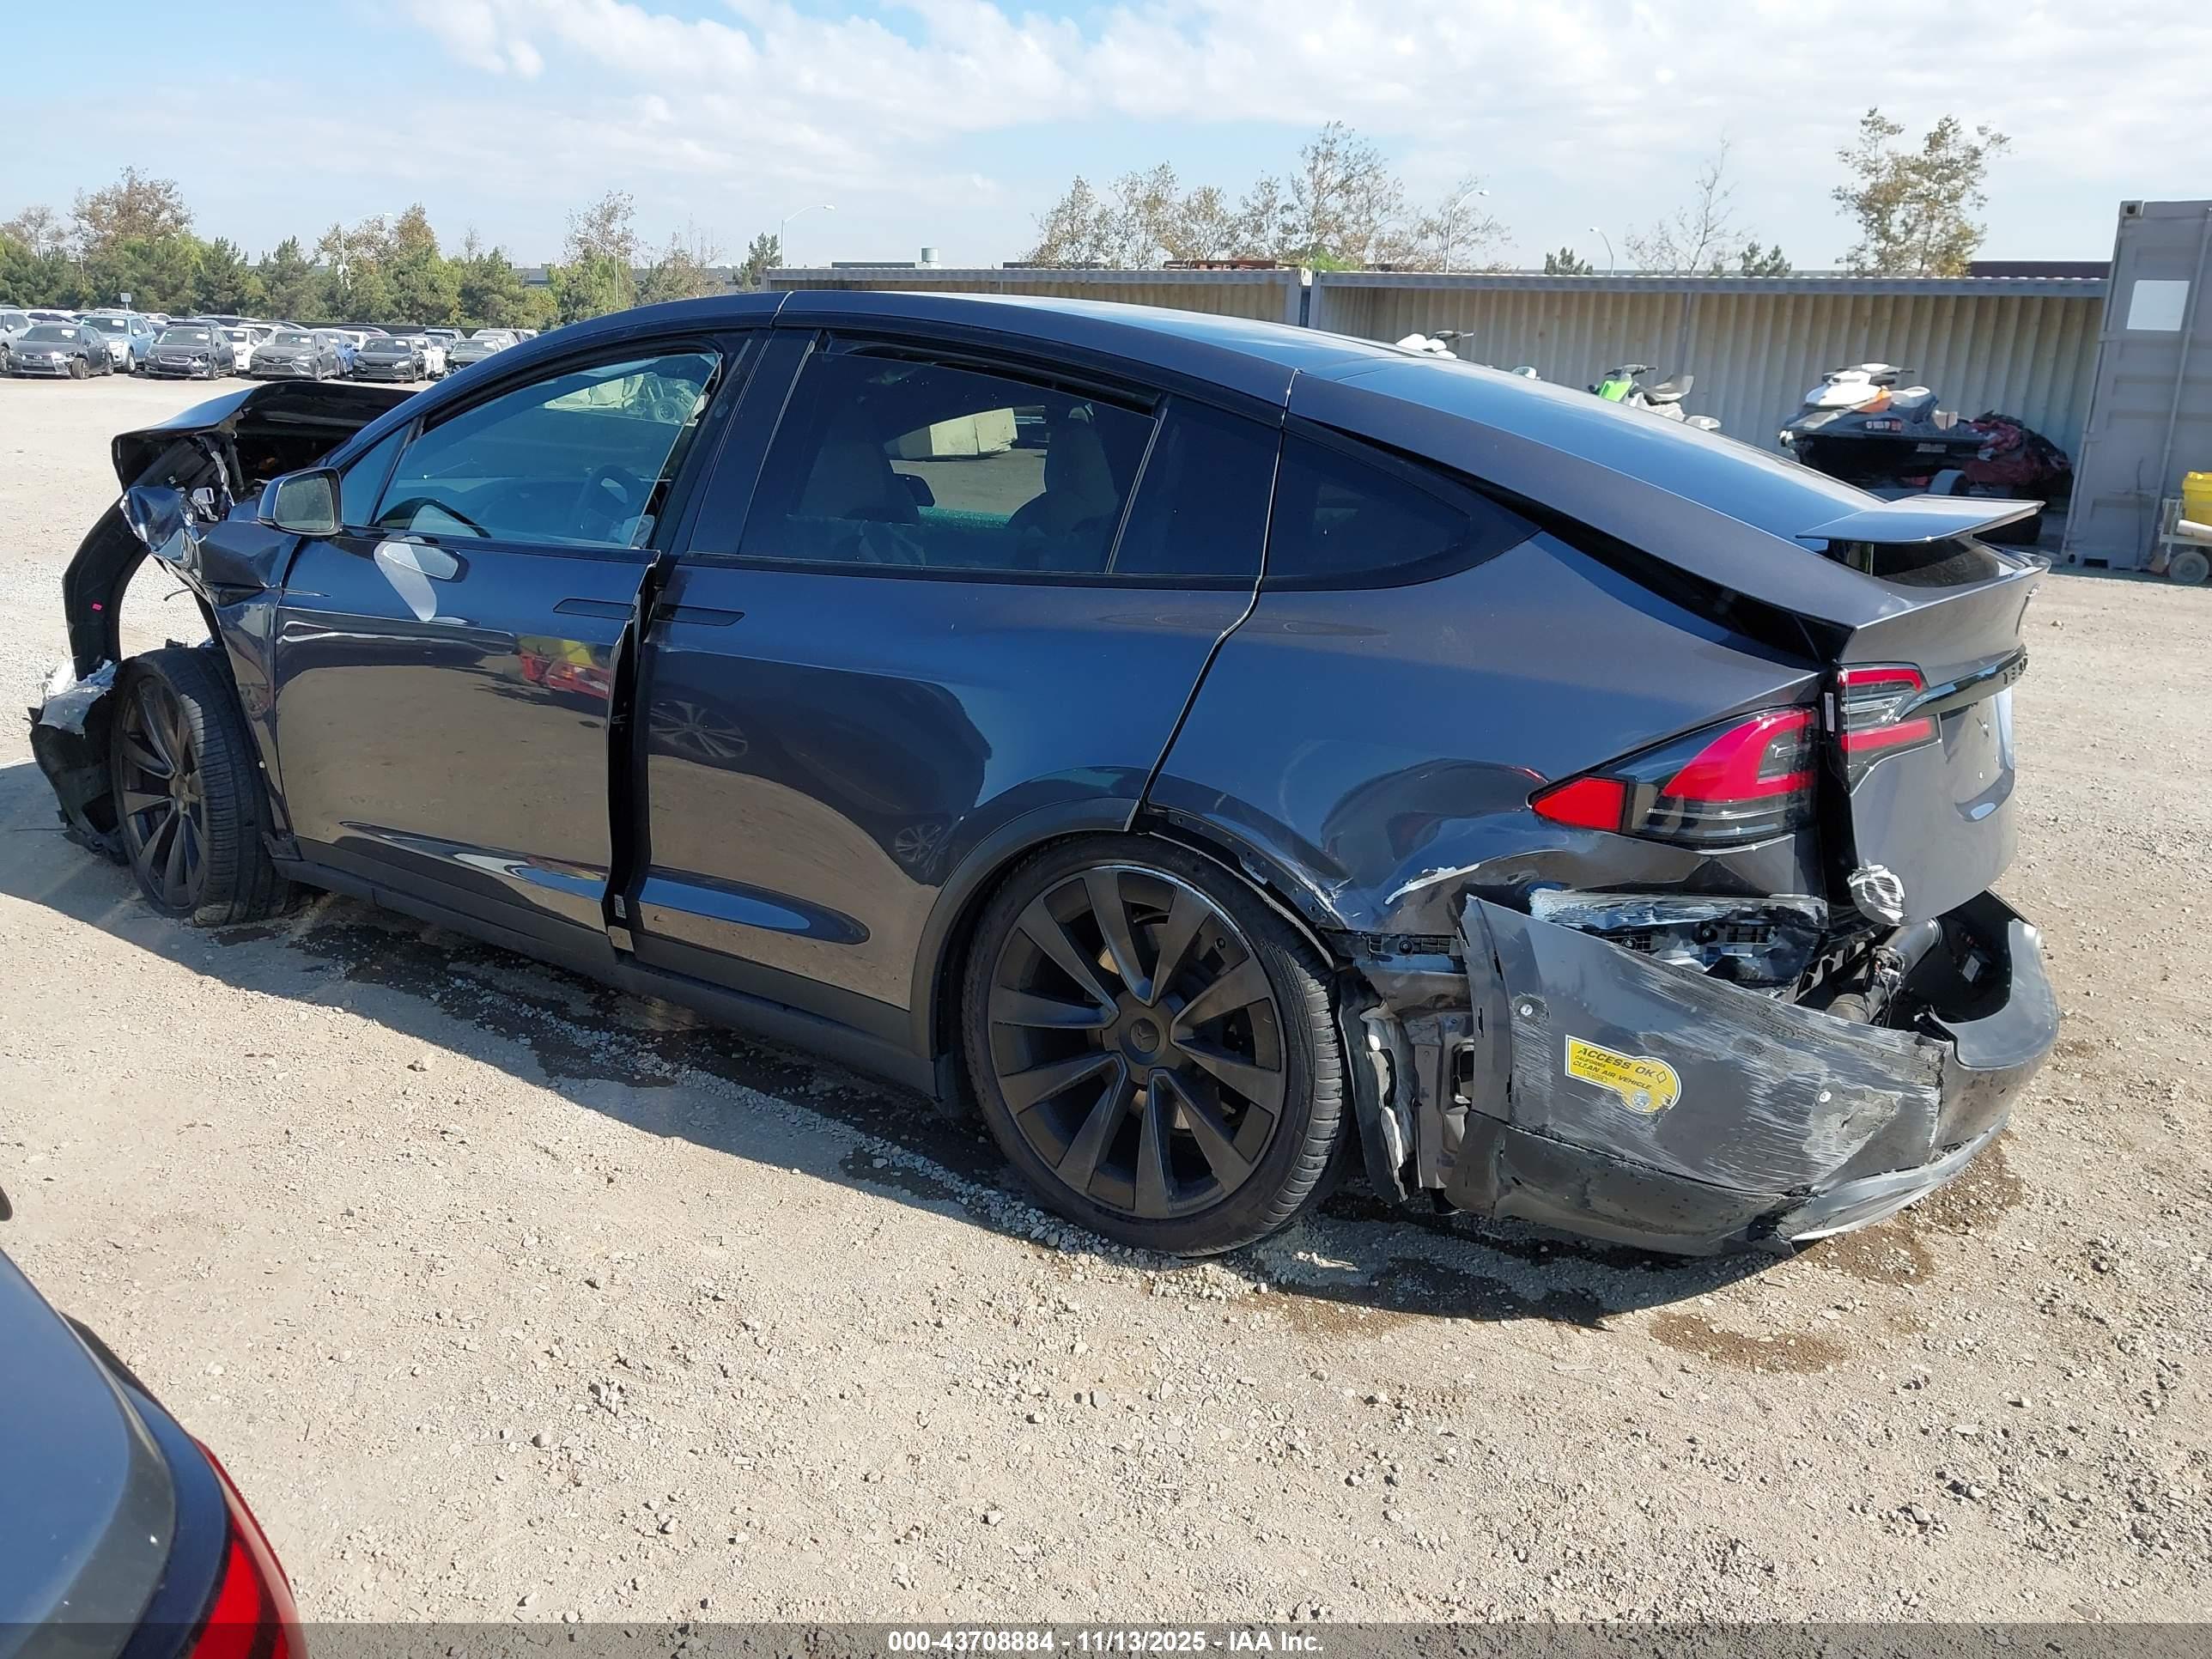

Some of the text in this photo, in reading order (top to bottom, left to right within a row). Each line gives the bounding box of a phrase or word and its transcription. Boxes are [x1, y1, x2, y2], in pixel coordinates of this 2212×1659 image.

[1573, 1060, 1600, 1073] CLEAN
[1601, 1069, 1616, 1079] AIR
[1619, 1075, 1652, 1091] VEHICLE
[1575, 1054, 1606, 1068] CALIFORNIA
[1577, 1048, 1656, 1078] ACCESS OK
